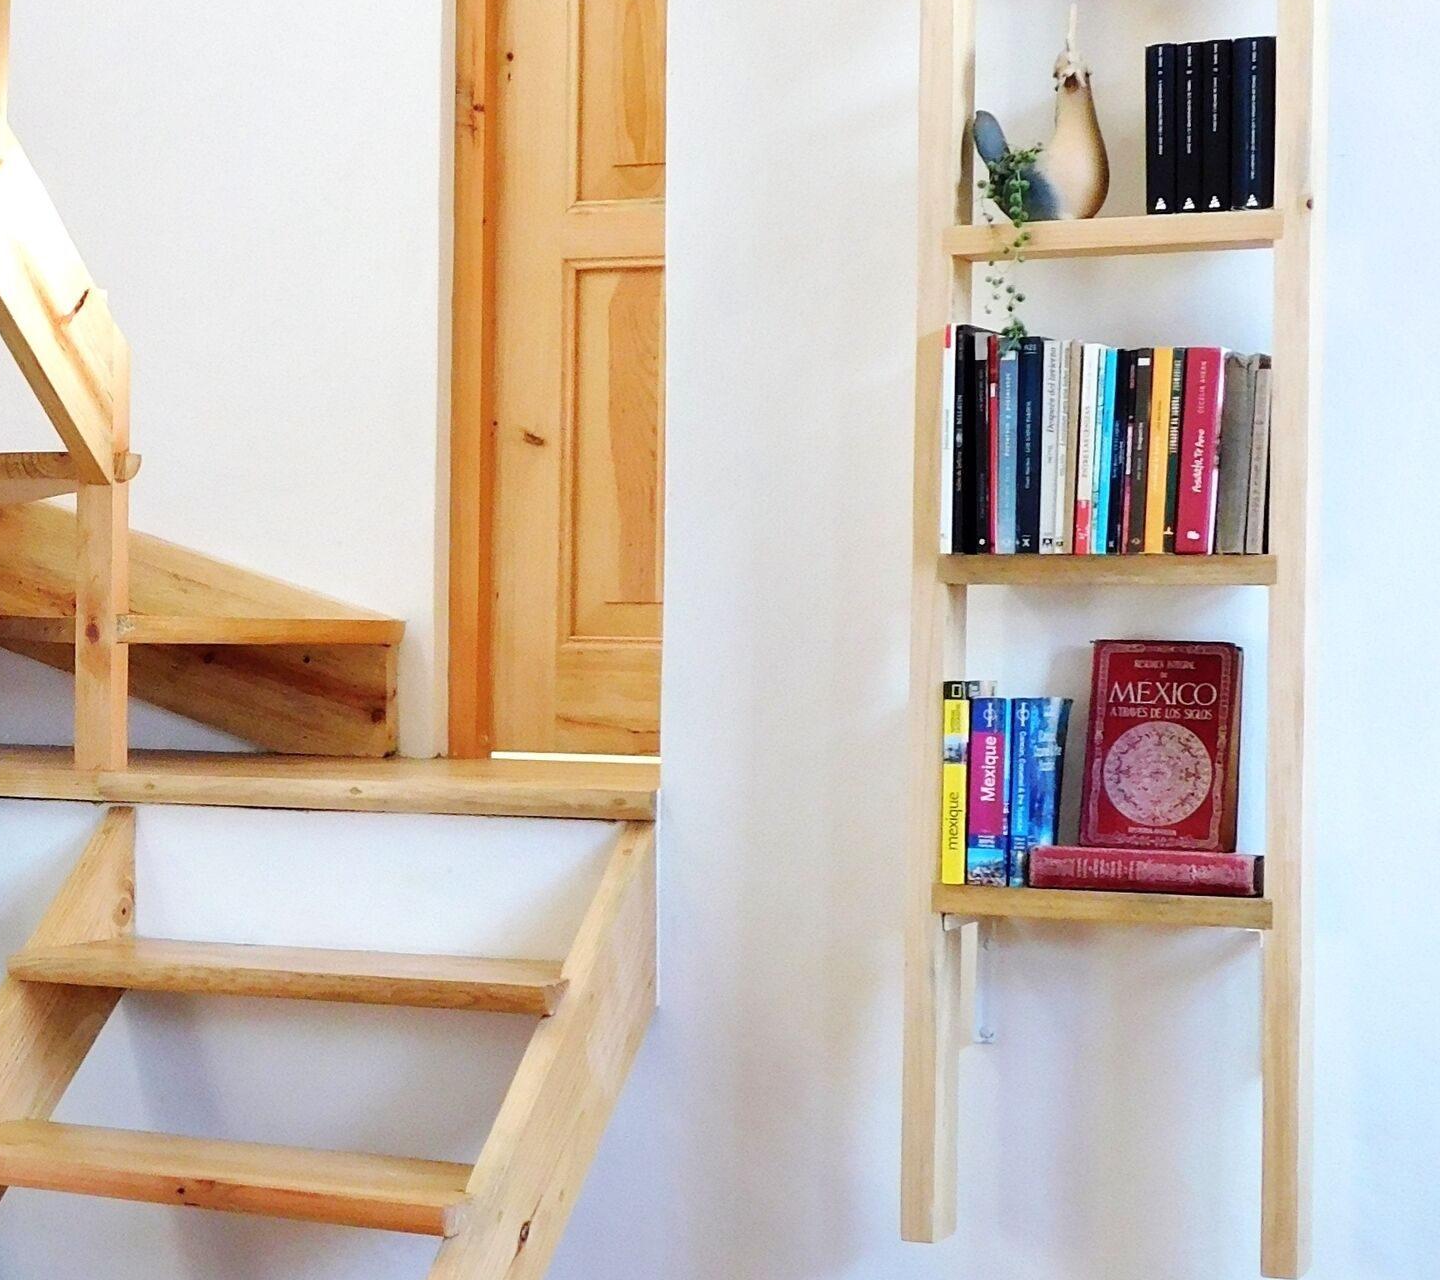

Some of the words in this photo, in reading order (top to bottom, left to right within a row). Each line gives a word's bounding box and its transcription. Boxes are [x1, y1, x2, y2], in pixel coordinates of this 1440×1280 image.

[1150, 707, 1162, 719] DE
[1164, 707, 1182, 719] LOS
[1183, 708, 1213, 720] SIGLOS
[980, 735, 998, 802] Mexique
[945, 791, 963, 851] mexique
